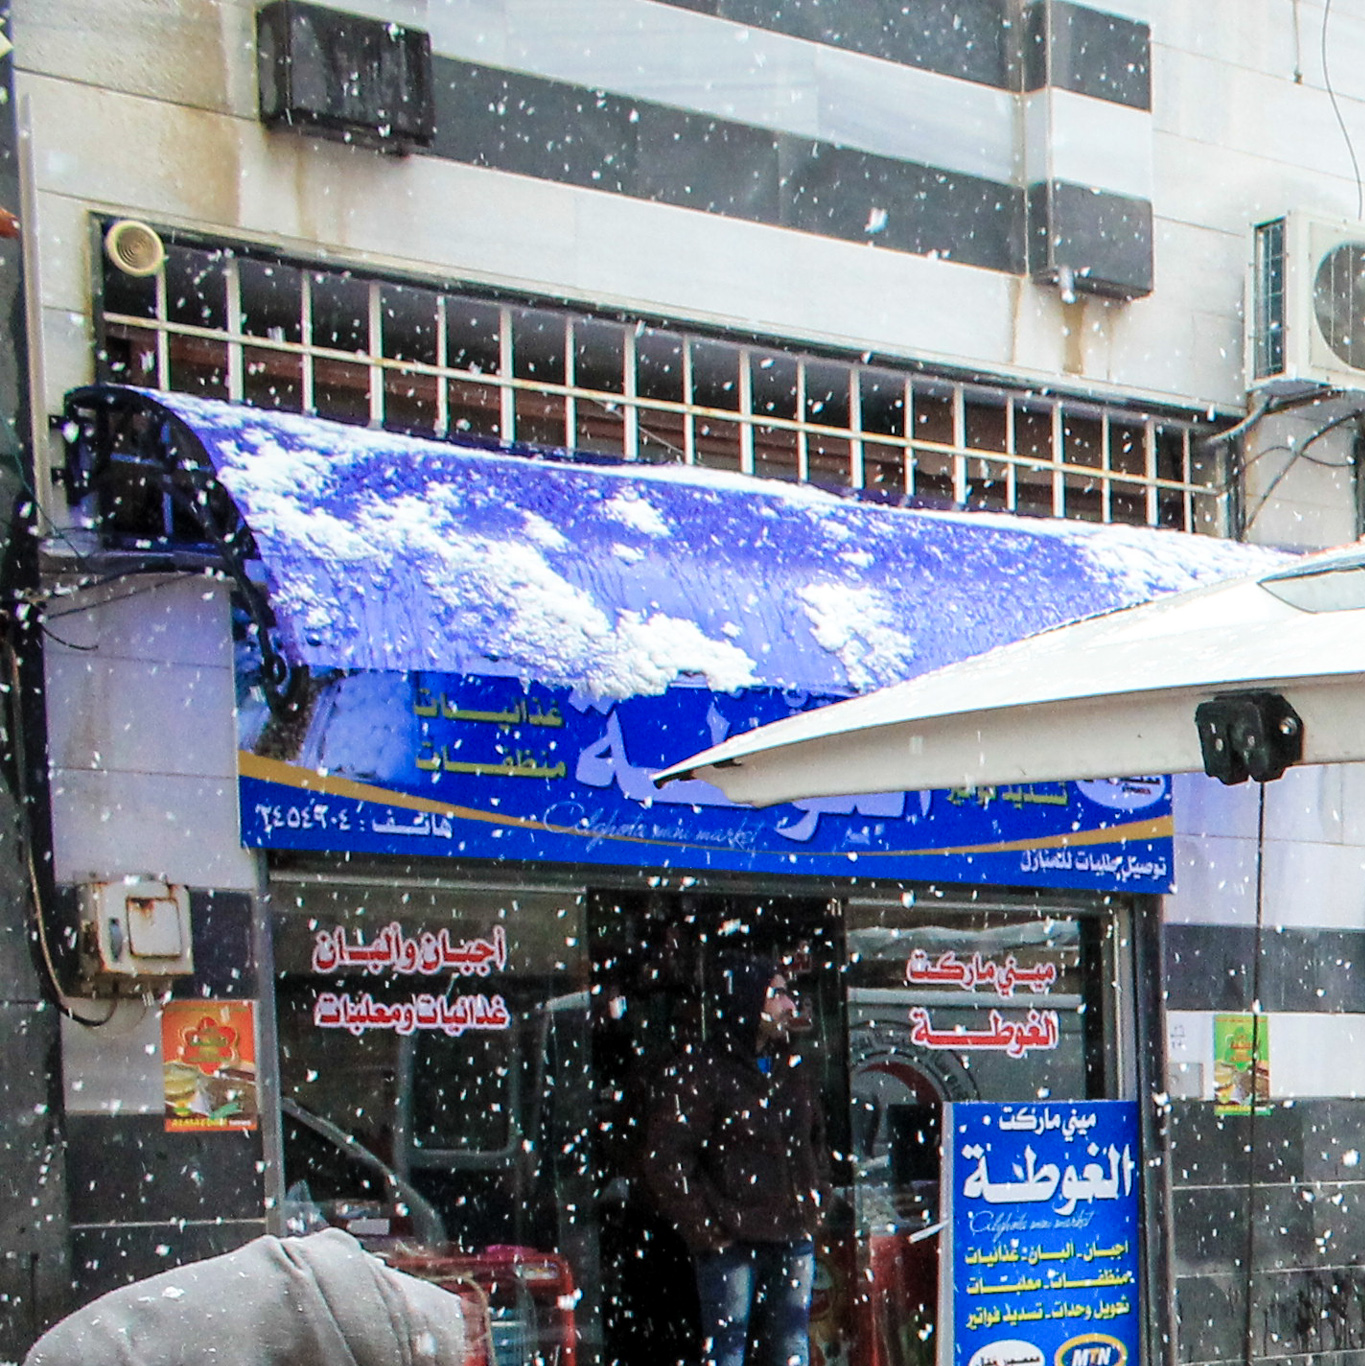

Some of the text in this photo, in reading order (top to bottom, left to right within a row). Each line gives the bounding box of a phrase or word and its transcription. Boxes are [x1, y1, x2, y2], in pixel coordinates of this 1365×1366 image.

[906, 949, 1057, 998] ميني ماركت
[909, 1007, 1059, 1059] الغوطة
[998, 1106, 1097, 1142] ميني ماركت
[961, 1143, 1135, 1216] الغوطة
